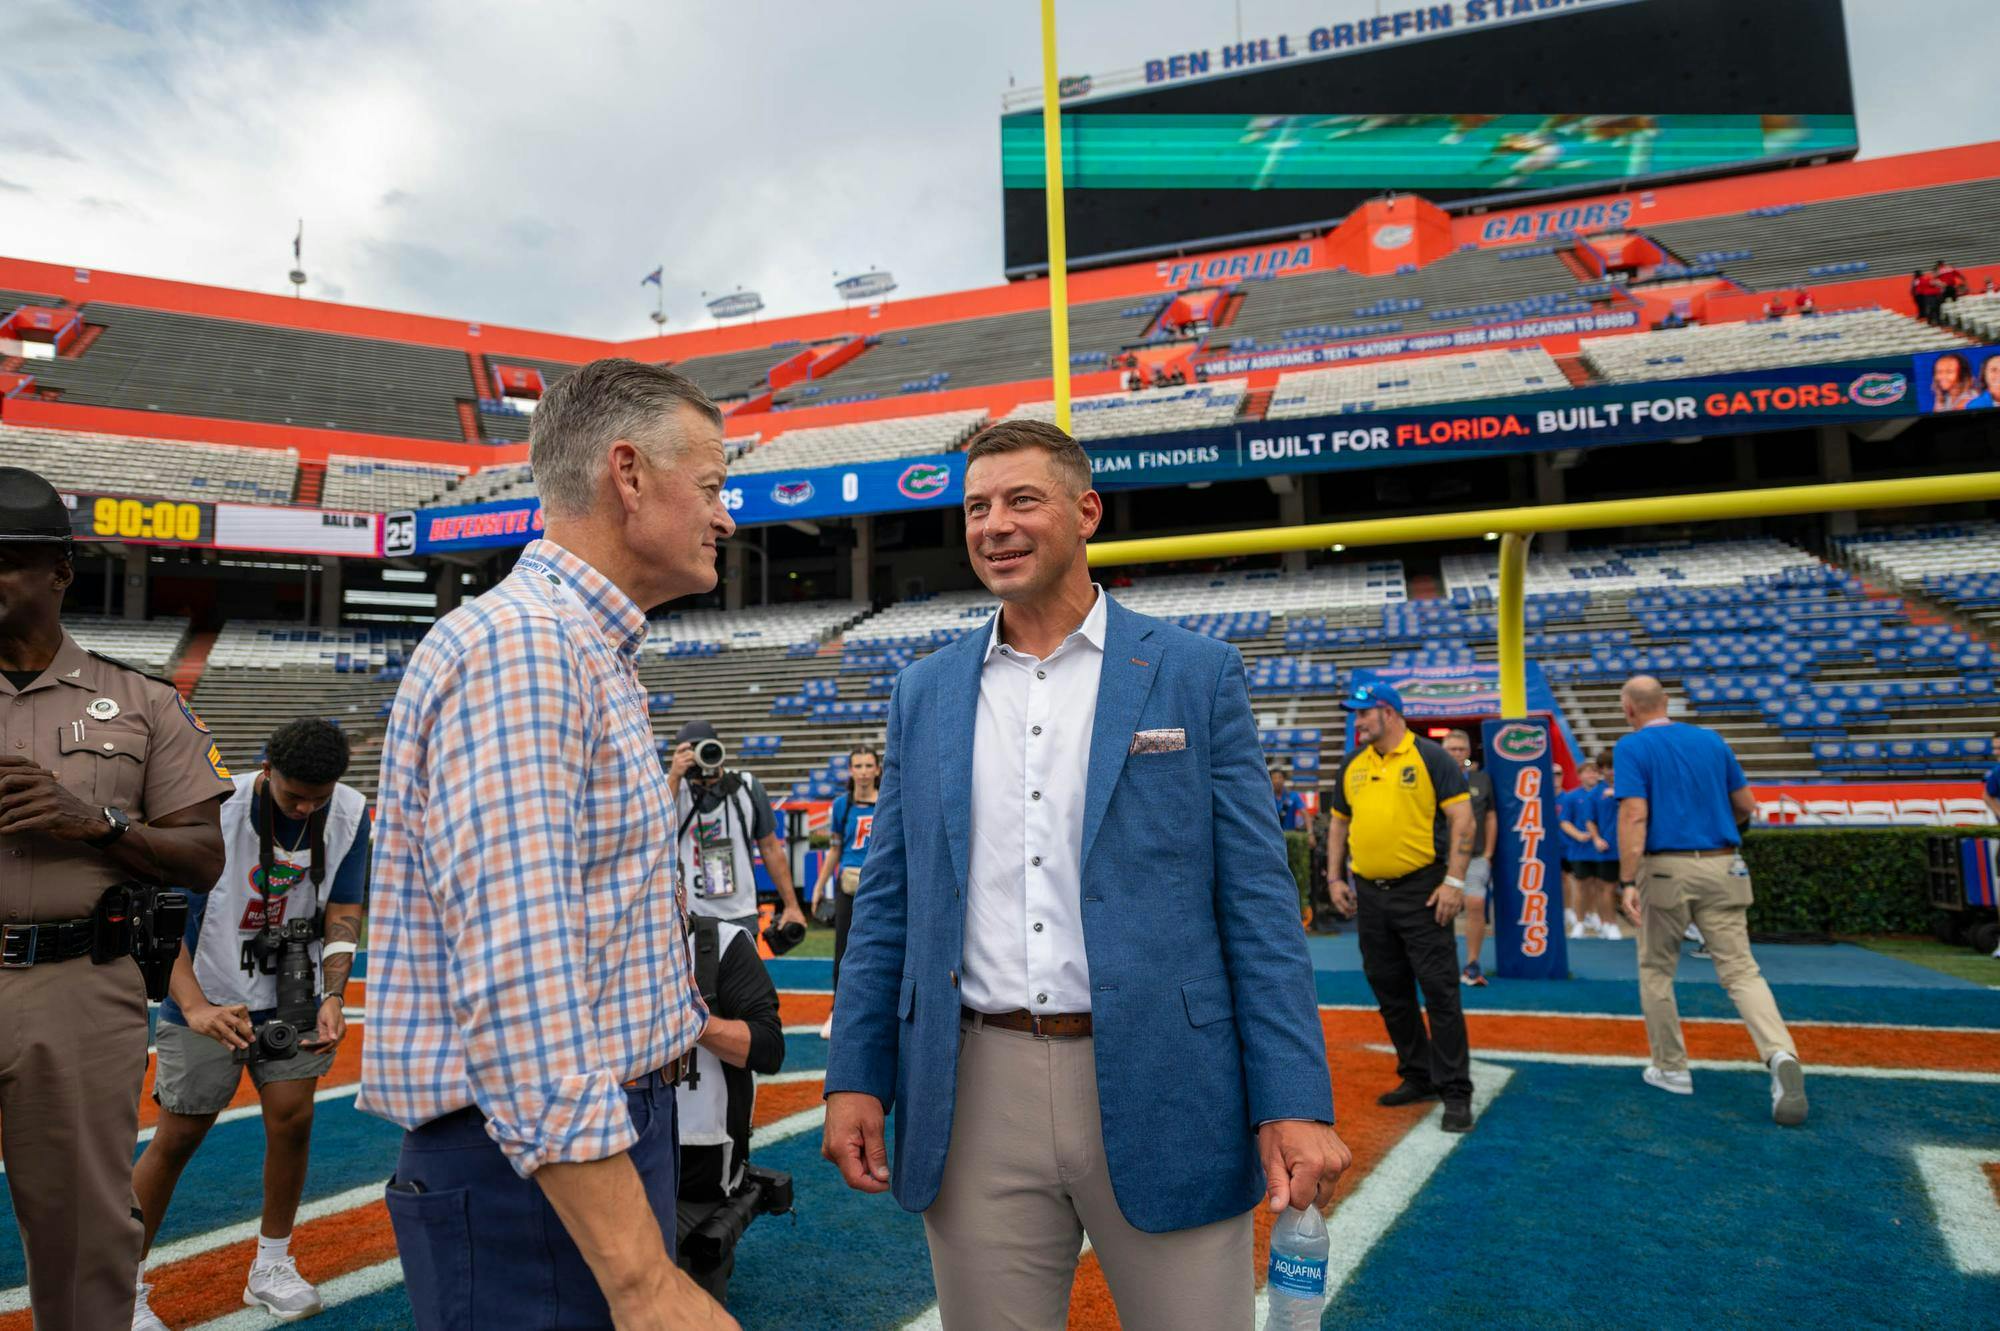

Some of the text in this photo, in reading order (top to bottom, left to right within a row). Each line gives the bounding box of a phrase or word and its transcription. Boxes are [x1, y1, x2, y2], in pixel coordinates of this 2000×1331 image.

[1145, 50, 1209, 83] BEN
[1223, 35, 1296, 68] HILL
[1309, 5, 1452, 52] GRIFFIN
[1482, 199, 1632, 241] GATORS
[1167, 245, 1312, 285] FLORIDA
[1229, 357, 1250, 372] DAY
[1250, 350, 1314, 369] ASSISTANCE
[1323, 346, 1350, 362] TEXT
[1454, 329, 1487, 346] ISSUE
[1488, 326, 1514, 342] AND
[1515, 319, 1575, 339] LOCATION
[1577, 316, 1594, 332] TO
[1249, 433, 1326, 462] BUILT
[1332, 426, 1390, 453] FOR
[1396, 414, 1530, 447] FLORIDA.
[1536, 403, 1624, 434] BUILT
[1631, 395, 1697, 425] FOR
[1704, 381, 1850, 417] GATORS.
[1138, 445, 1220, 470] FINDERS
[842, 472, 859, 502] 0
[93, 497, 201, 541] 90:00
[322, 513, 369, 529] BALL ON
[387, 520, 414, 547] 25
[429, 508, 531, 542] DEFENSIVE
[1512, 765, 1549, 957] GATORS
[1275, 1259, 1322, 1280] AQUAFINA
